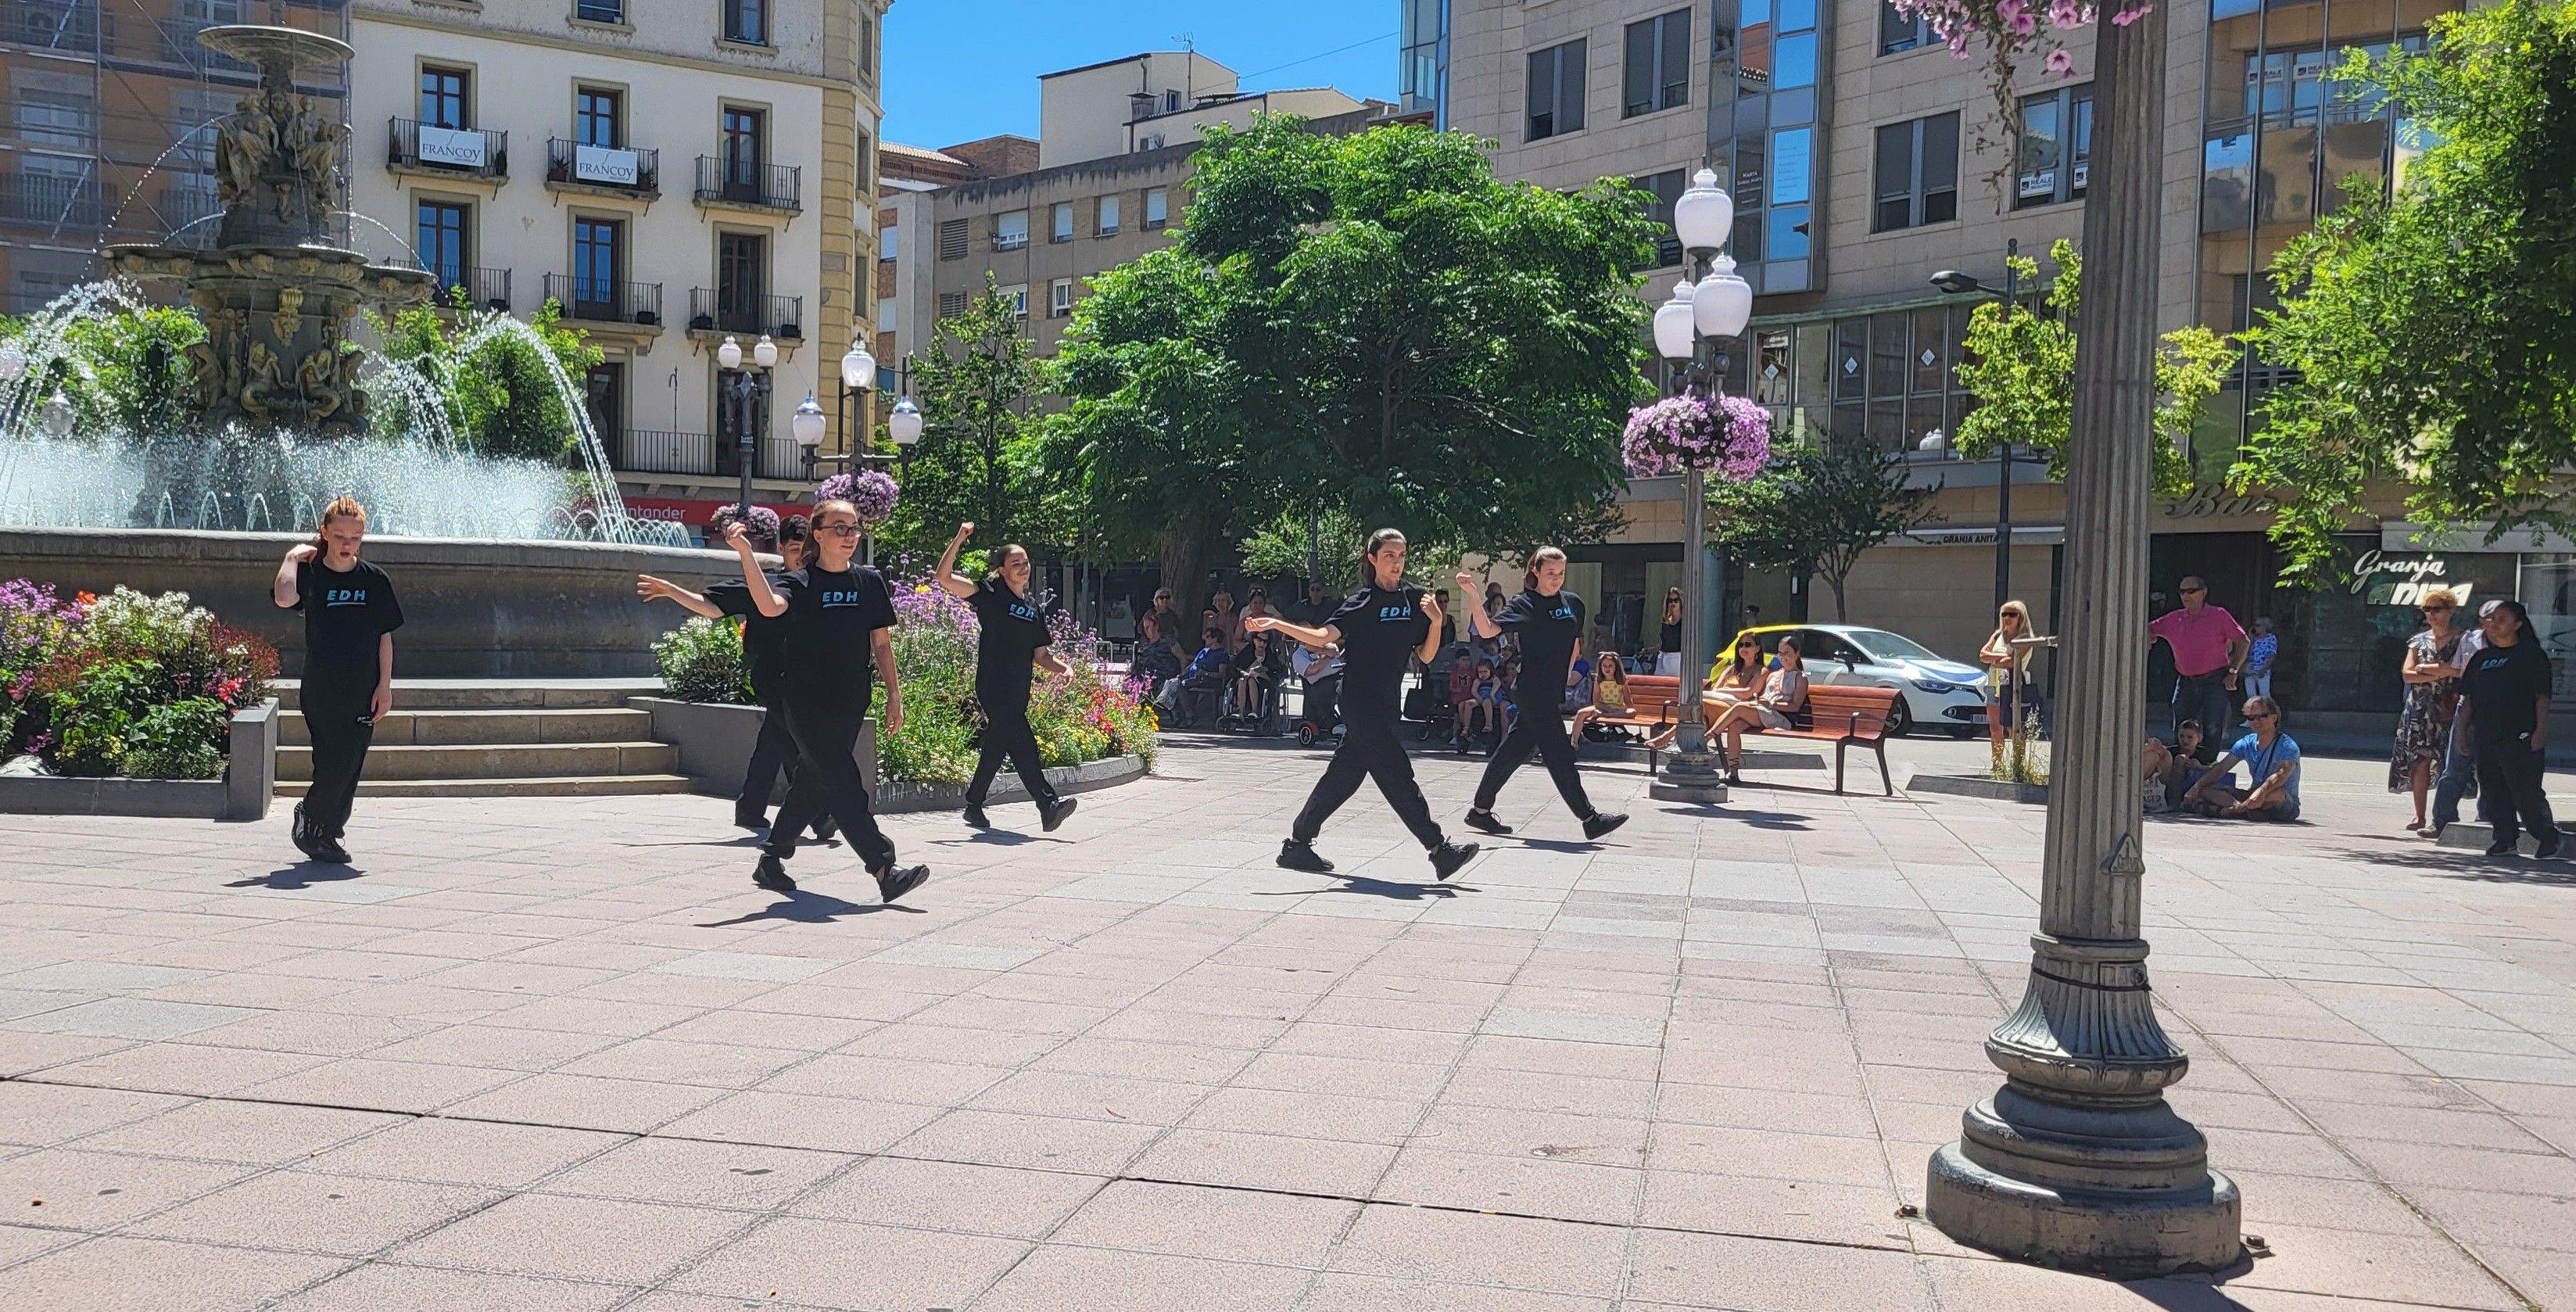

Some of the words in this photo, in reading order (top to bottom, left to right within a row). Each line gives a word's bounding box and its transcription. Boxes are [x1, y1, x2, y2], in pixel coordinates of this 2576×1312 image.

[422, 143, 481, 163] FRANCOY
[579, 163, 634, 181] FRANCOY
[626, 504, 686, 520] ntander
[2350, 550, 2445, 594] Granja
[327, 590, 366, 601] EDH
[822, 591, 858, 602] EDH
[1009, 604, 1035, 618] EDH
[1380, 607, 1411, 618] EDH
